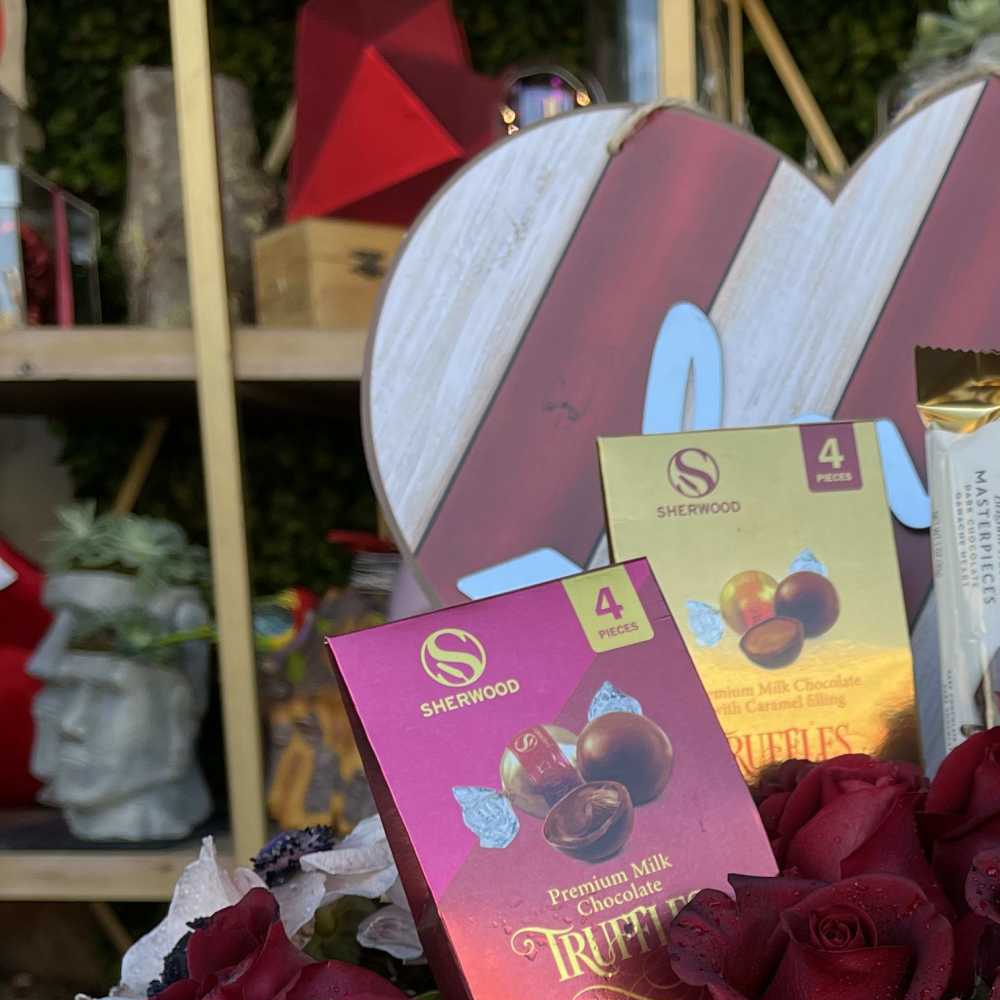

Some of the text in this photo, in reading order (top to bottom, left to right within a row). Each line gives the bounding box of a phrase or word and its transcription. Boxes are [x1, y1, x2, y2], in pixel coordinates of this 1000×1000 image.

[818, 438, 845, 469] 4
[816, 472, 853, 484] PIECES
[656, 501, 741, 519] SHERWOOD
[975, 470, 997, 605] MASTERPIECES
[595, 586, 624, 623] 4
[598, 621, 640, 640] PIECES
[420, 678, 521, 718] SHERWOOD
[759, 680, 790, 696] Milk
[793, 674, 863, 692] Chocolate
[745, 698, 803, 713] Caramel
[548, 853, 673, 906] Premium Milk
[577, 878, 664, 917] Chocolate
[511, 888, 702, 983] TRUFFL
